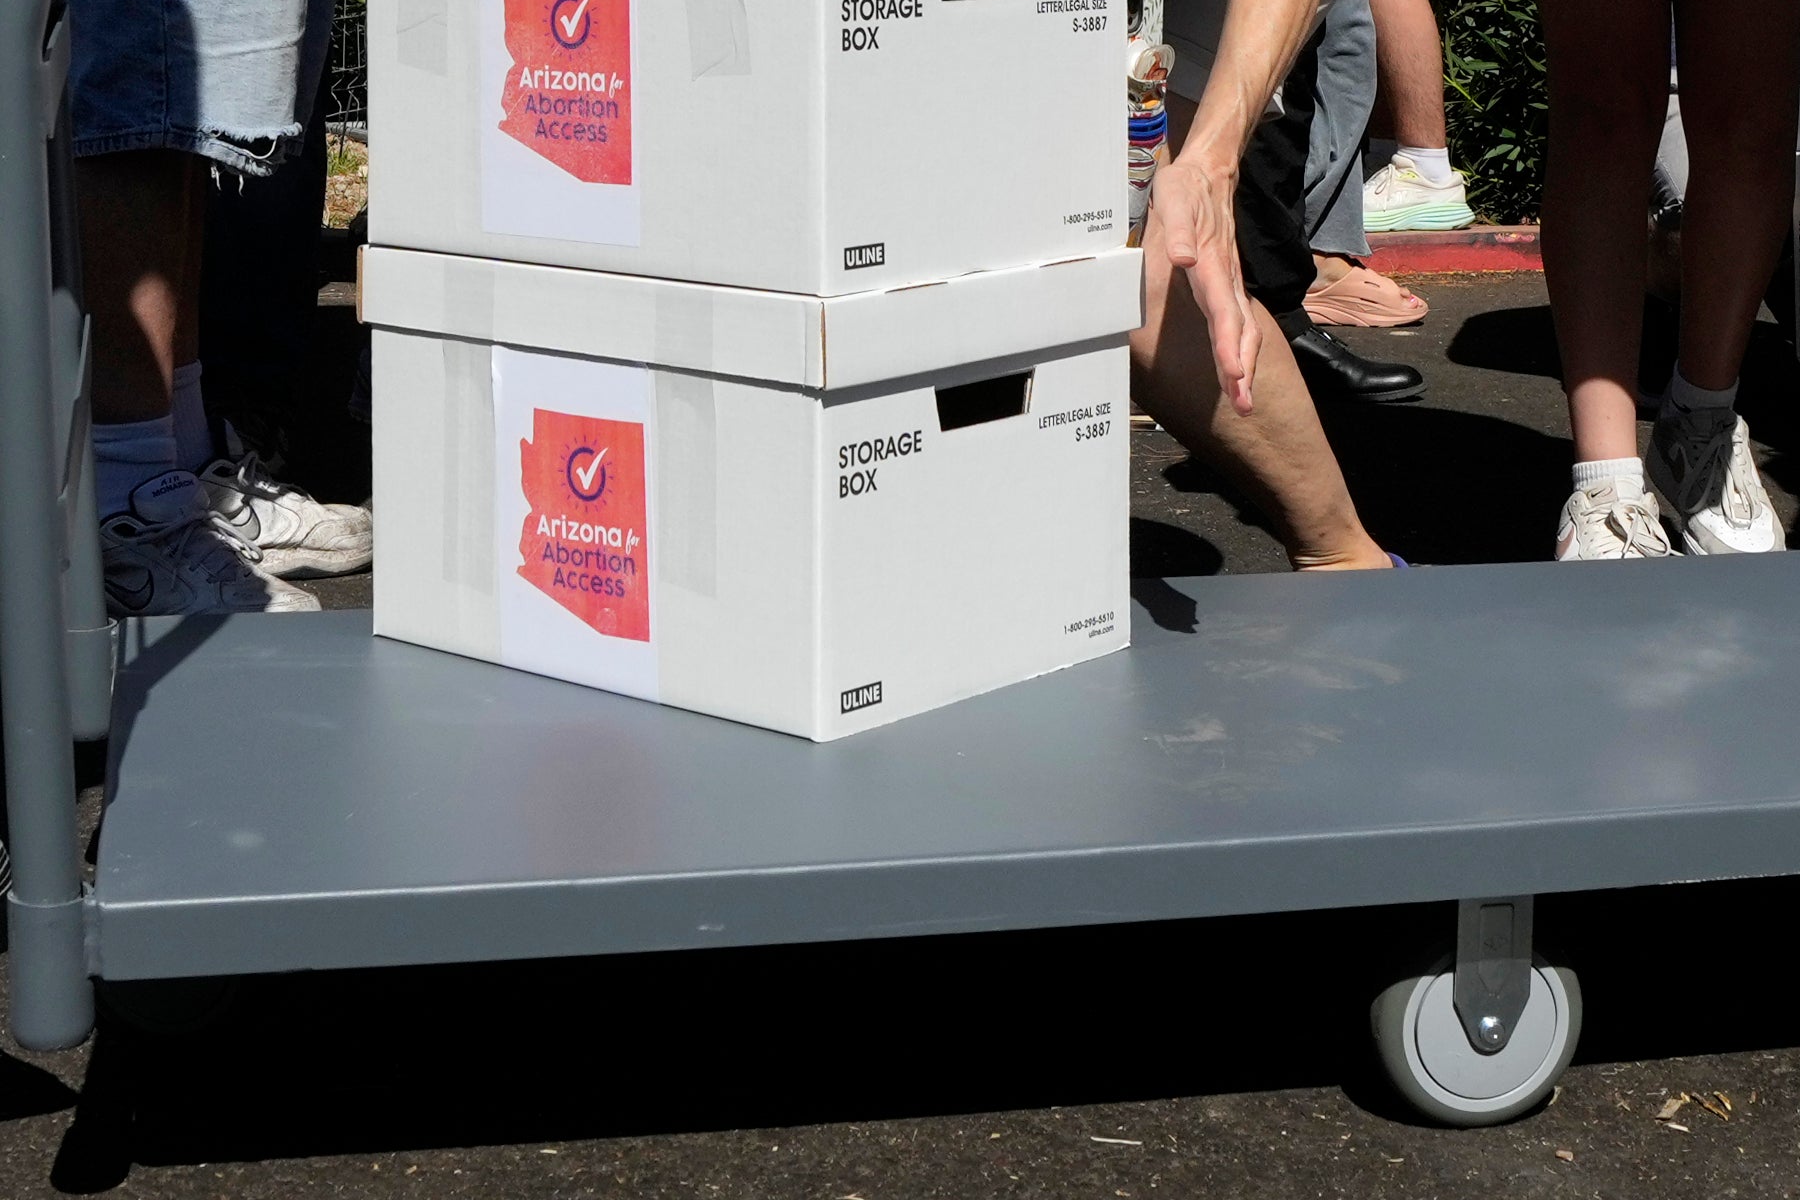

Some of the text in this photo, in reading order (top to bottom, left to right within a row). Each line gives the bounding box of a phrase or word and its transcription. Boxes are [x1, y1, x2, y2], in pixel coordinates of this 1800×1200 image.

[1036, 0, 1090, 14] LETTER/LEGAL
[1072, 16, 1107, 32] S-3887
[841, 26, 879, 51] BOX
[519, 65, 624, 98] Arizona for
[525, 93, 619, 118] Abortion
[534, 118, 608, 143] Access
[845, 246, 883, 267] ULINE
[1038, 402, 1111, 429] LETTER/LEGAL SIZE
[1075, 421, 1111, 442] S-3887
[838, 430, 922, 469] STORAGE
[838, 468, 877, 498] BOX
[537, 514, 640, 554] Arizona for
[542, 541, 636, 575] Abortion
[553, 567, 625, 598] Access
[842, 683, 881, 711] ULINE
